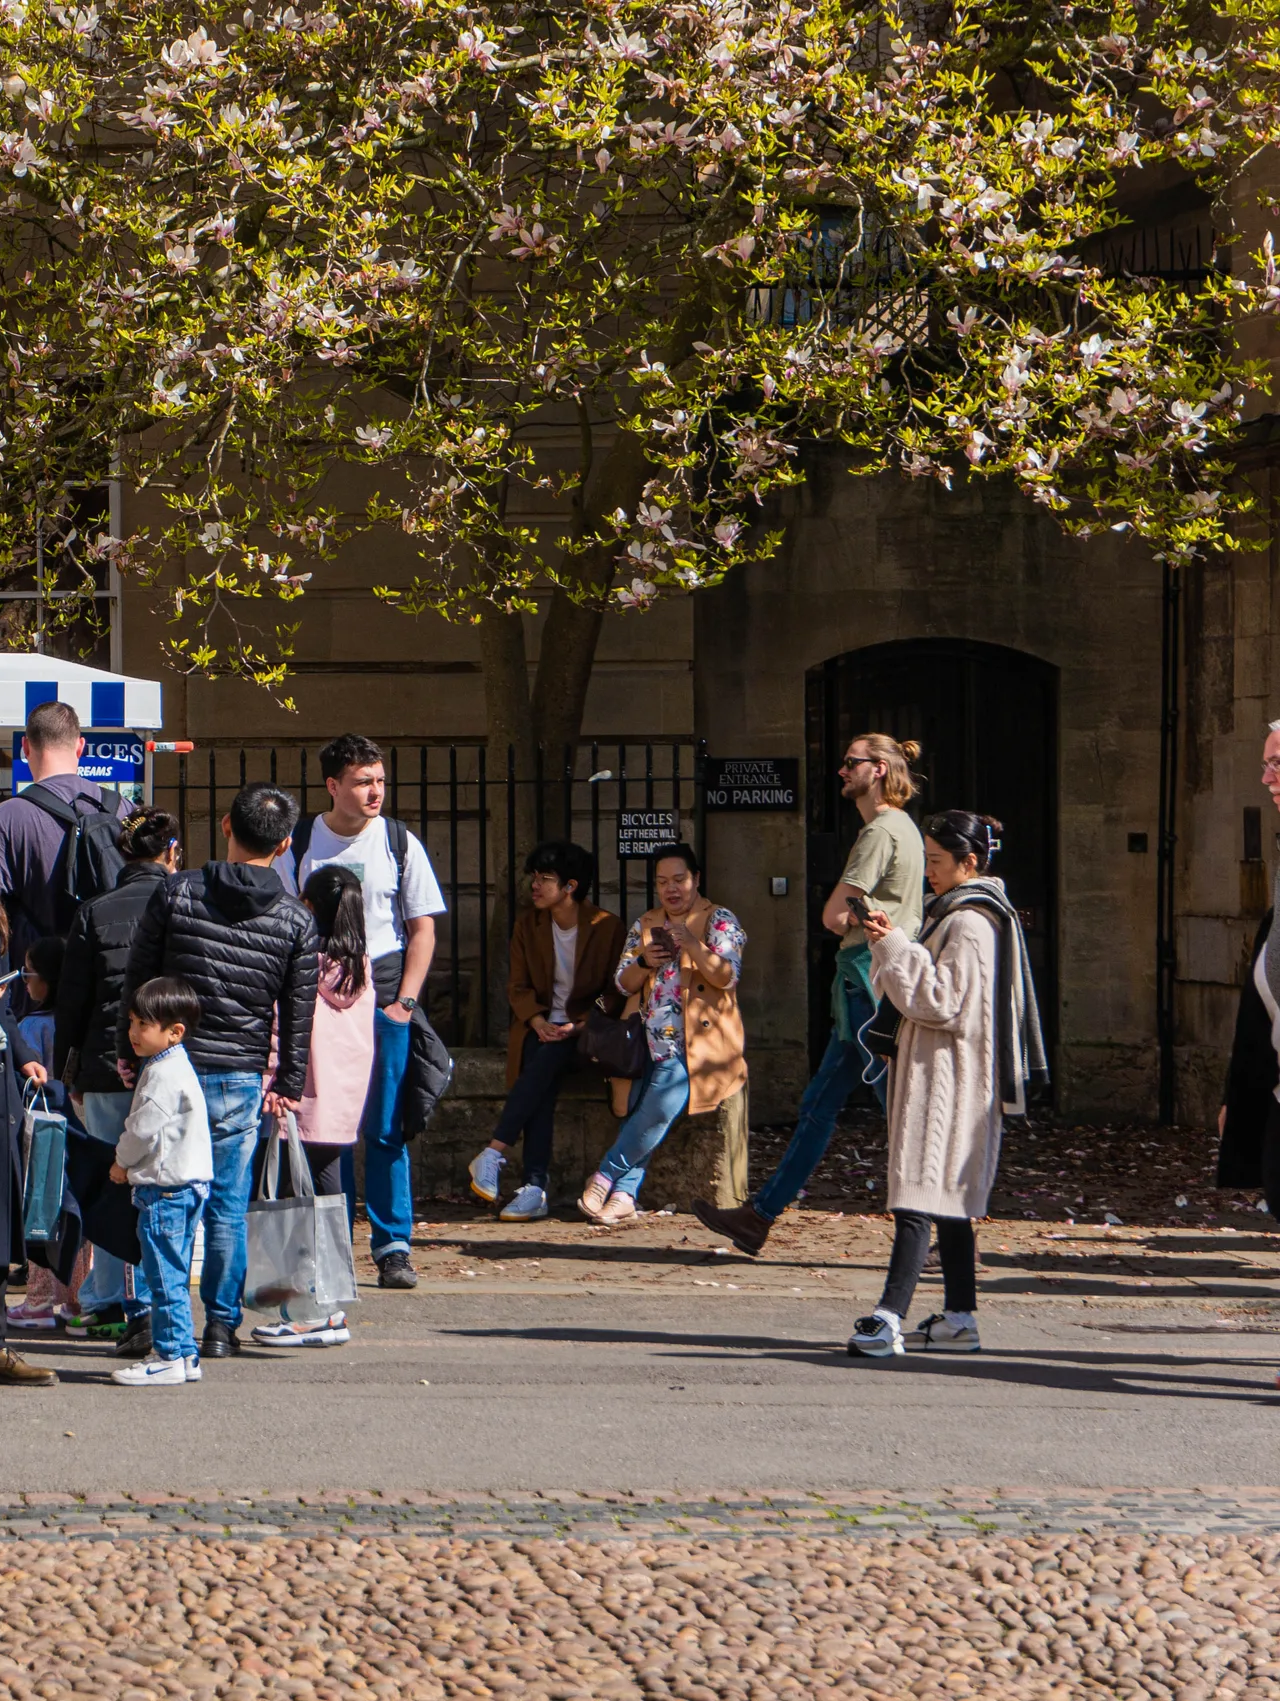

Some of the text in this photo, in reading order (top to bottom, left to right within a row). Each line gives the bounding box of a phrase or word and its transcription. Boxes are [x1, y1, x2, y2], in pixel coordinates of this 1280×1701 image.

[77, 766, 113, 777] REAMS
[724, 763, 775, 773] PRIVATE
[719, 774, 781, 784] ENTRANCE
[707, 789, 794, 805] NO PARKING
[621, 813, 673, 826] BICYCLES
[619, 828, 676, 839] LEFT HERE WILL
[619, 842, 631, 854] BE
